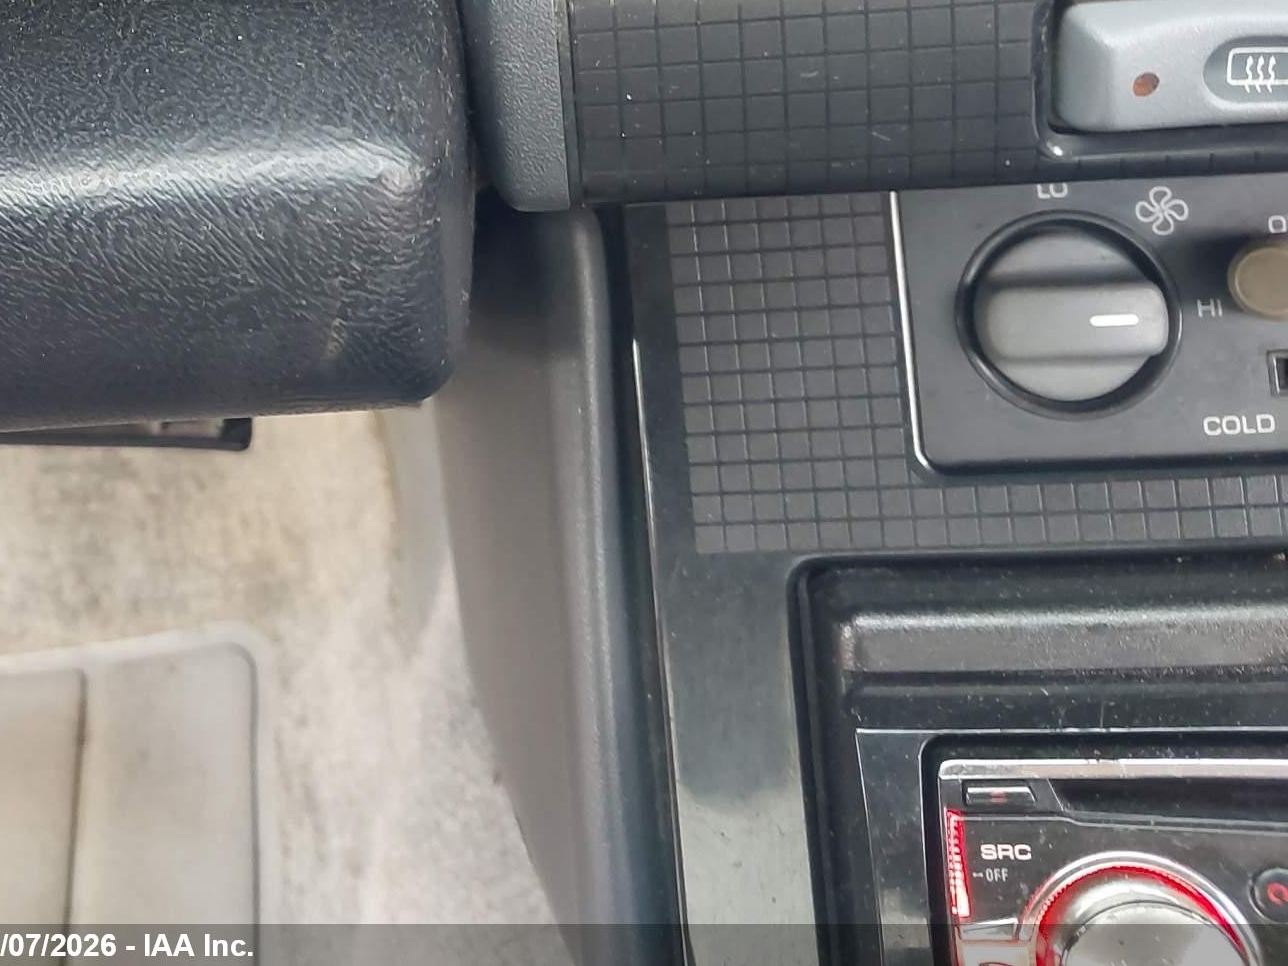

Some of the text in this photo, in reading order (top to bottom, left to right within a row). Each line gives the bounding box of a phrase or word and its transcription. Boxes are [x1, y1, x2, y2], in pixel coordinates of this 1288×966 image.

[1036, 183, 1069, 199] LO
[1196, 298, 1224, 318] HI
[1202, 413, 1276, 436] COLD
[979, 843, 1033, 861] SRC
